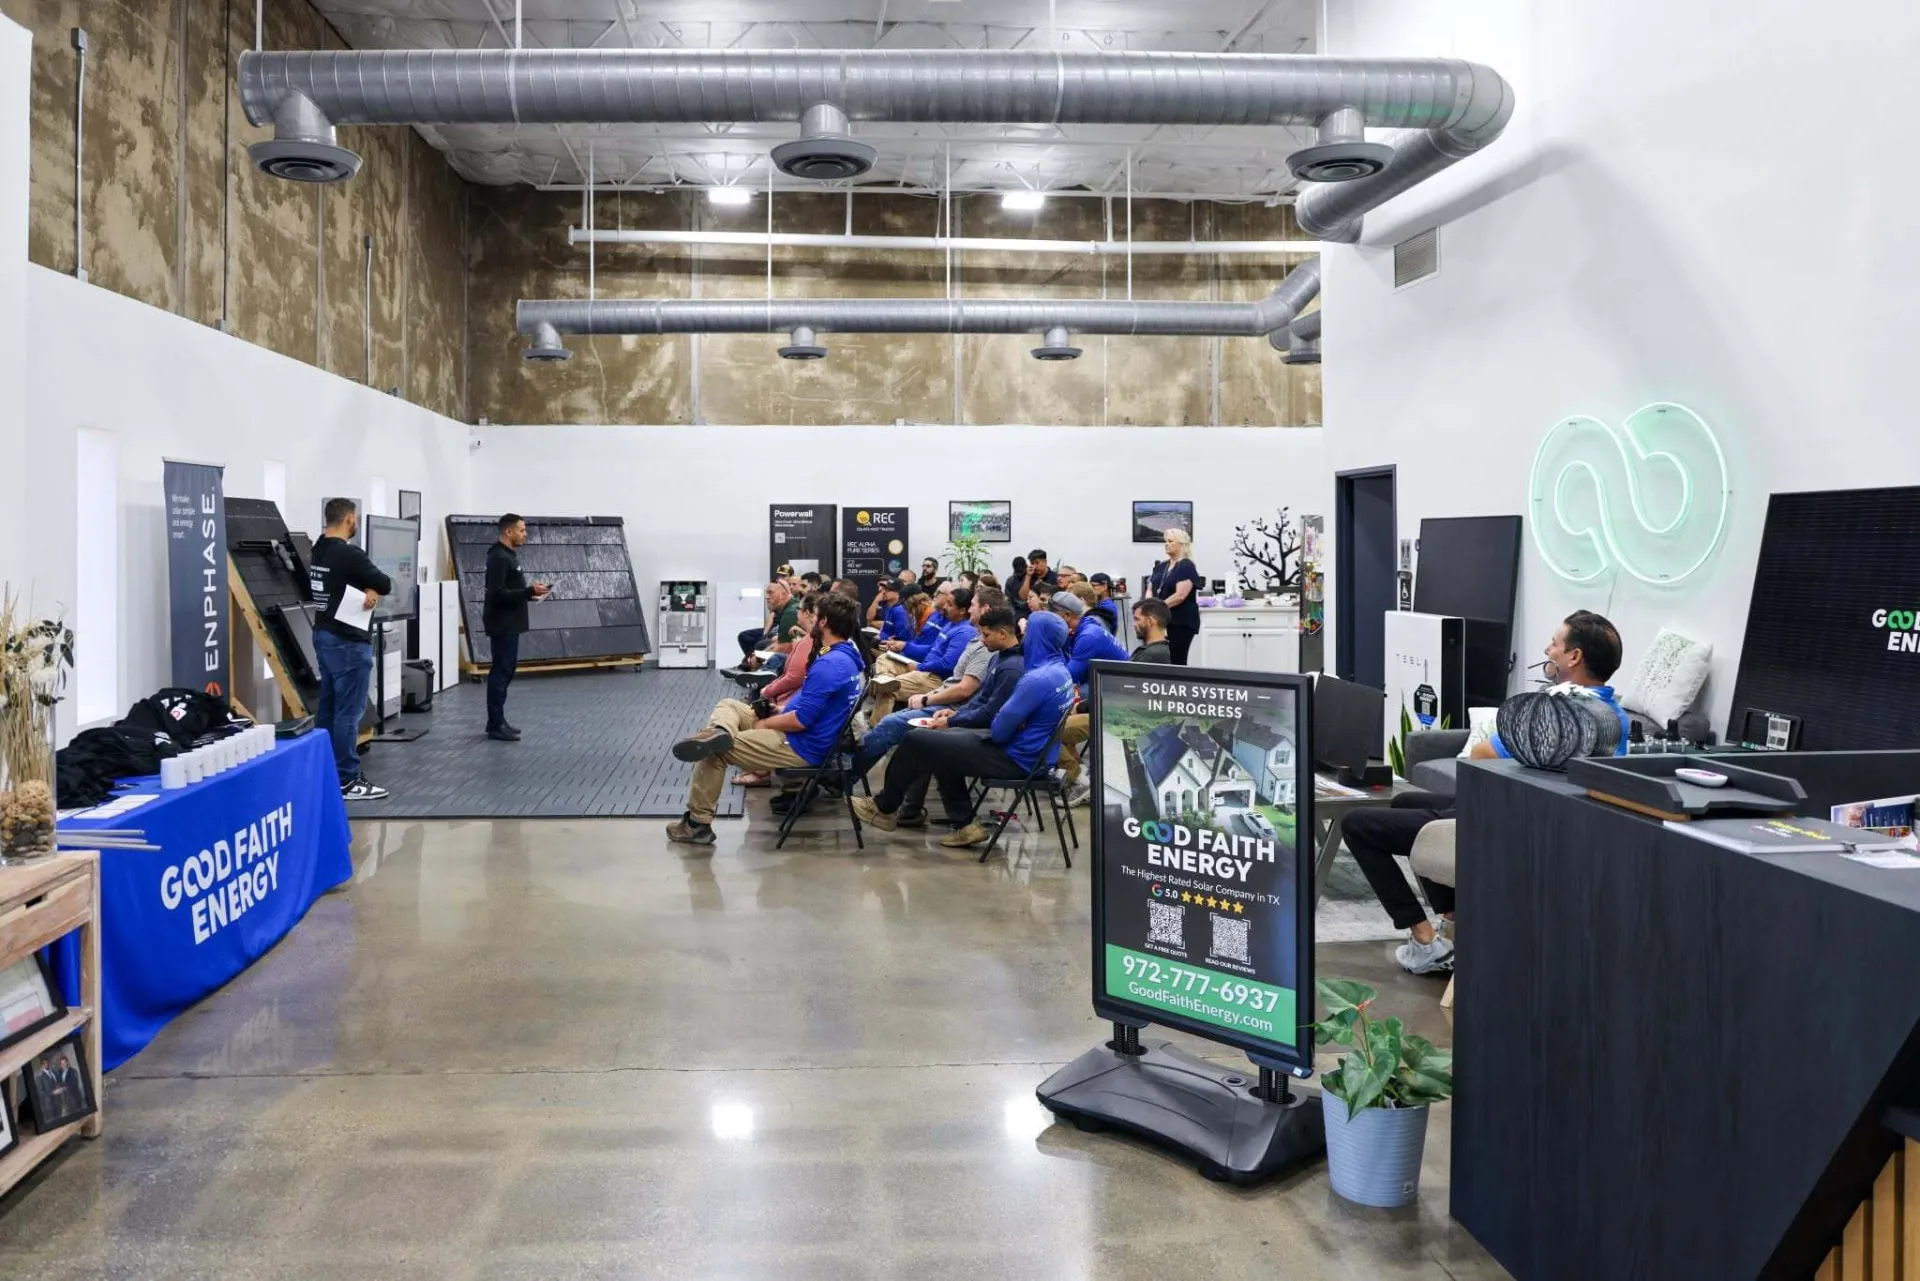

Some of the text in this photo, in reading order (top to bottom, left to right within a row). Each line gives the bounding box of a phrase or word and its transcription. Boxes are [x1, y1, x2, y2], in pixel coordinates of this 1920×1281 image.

[774, 509, 814, 518] Powerwall
[873, 512, 896, 524] REC
[201, 492, 220, 673] ENPHASE
[1887, 631, 1920, 653] EN
[1142, 682, 1249, 702] SOLAR SYSTEM
[1148, 699, 1243, 719] IN PROGRESS
[160, 801, 293, 911] GOOD FAITH
[1123, 817, 1275, 863] GOOD FAITH
[1147, 843, 1253, 883] ENERGY
[191, 850, 280, 946] ENERGY
[1121, 865, 1281, 906] The Highest Rated Solar Company in TX
[1165, 889, 1178, 900] 5.0
[1122, 955, 1279, 1014] 972-777-6937
[1205, 957, 1256, 975] READ OUR REVIEWS
[1128, 981, 1273, 1033] GoodFaithEnergy.com
